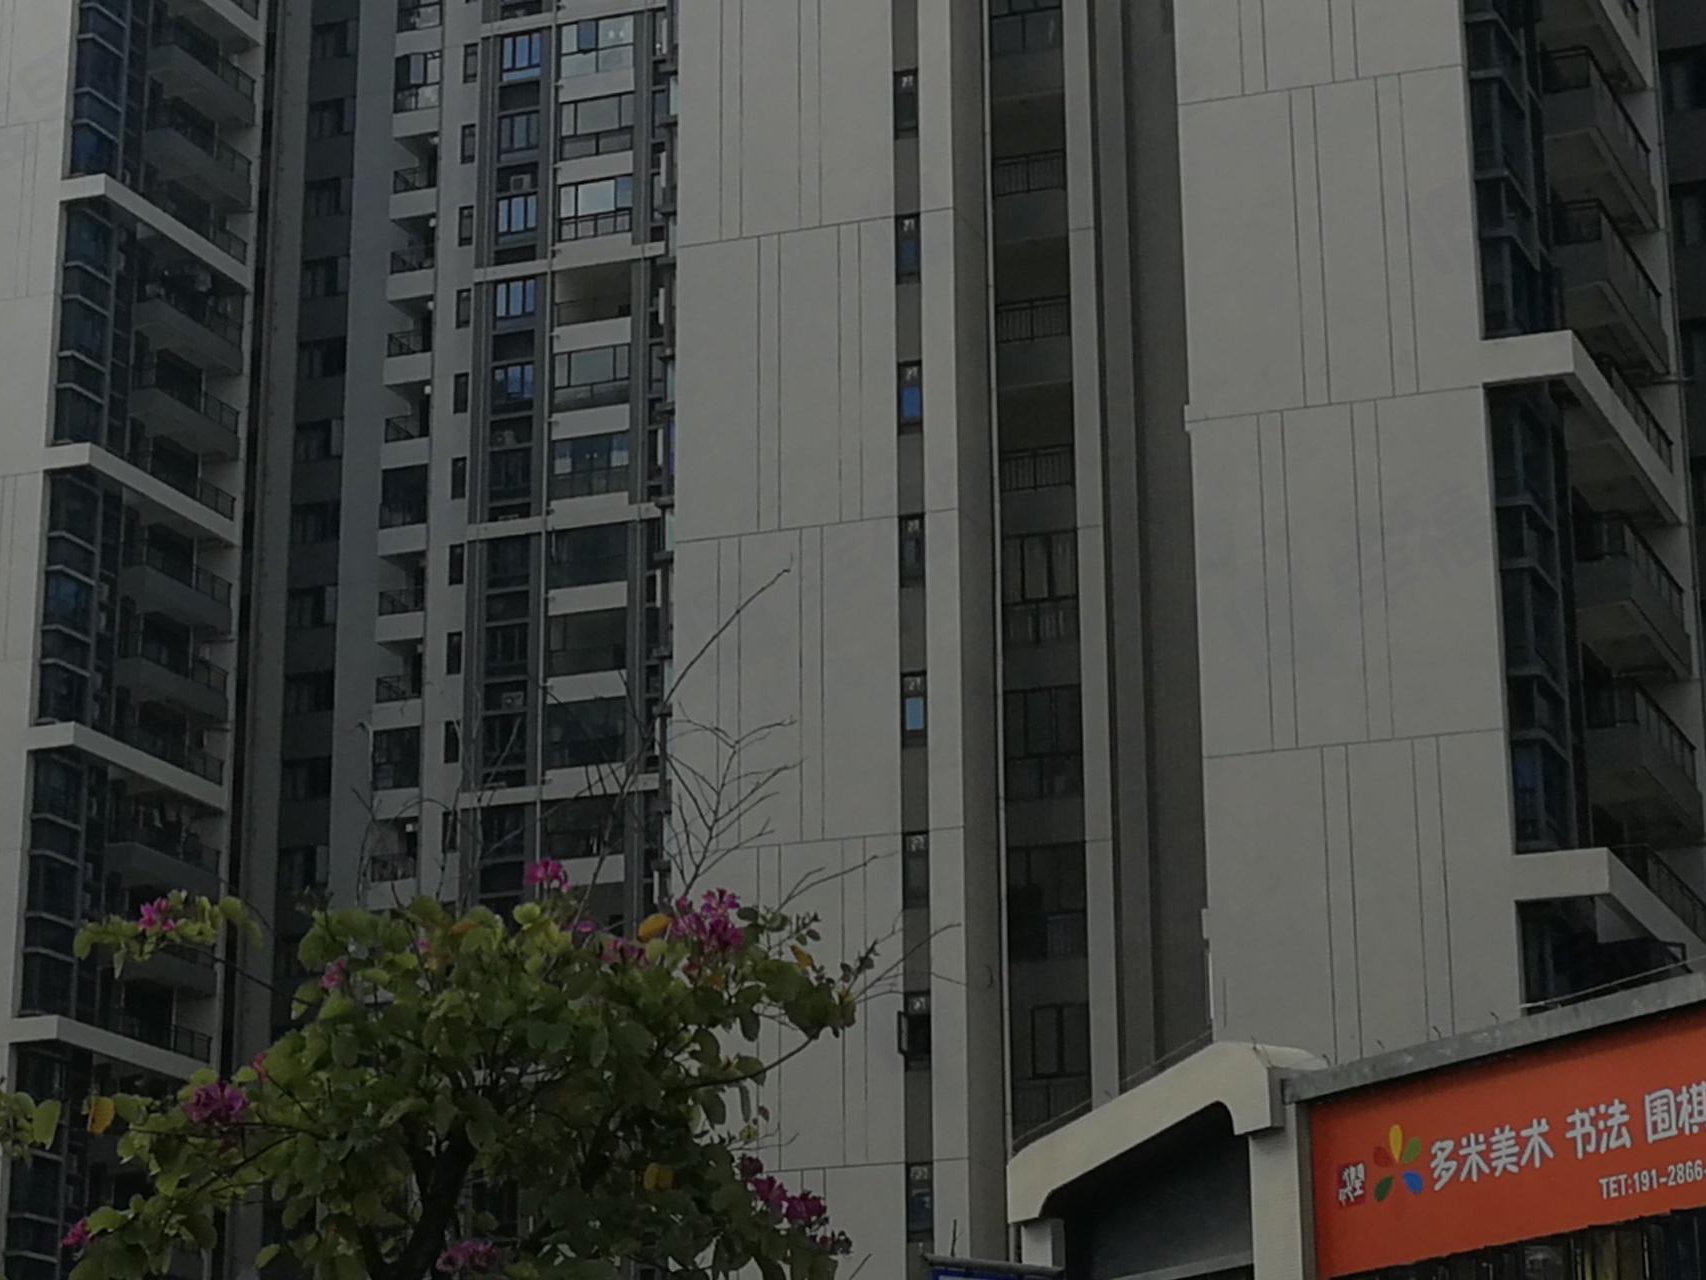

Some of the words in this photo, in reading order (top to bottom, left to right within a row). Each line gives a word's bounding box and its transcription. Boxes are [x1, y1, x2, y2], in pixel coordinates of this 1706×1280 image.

[1430, 1118, 1554, 1191] 多米美术
[1565, 1099, 1633, 1159] 书法
